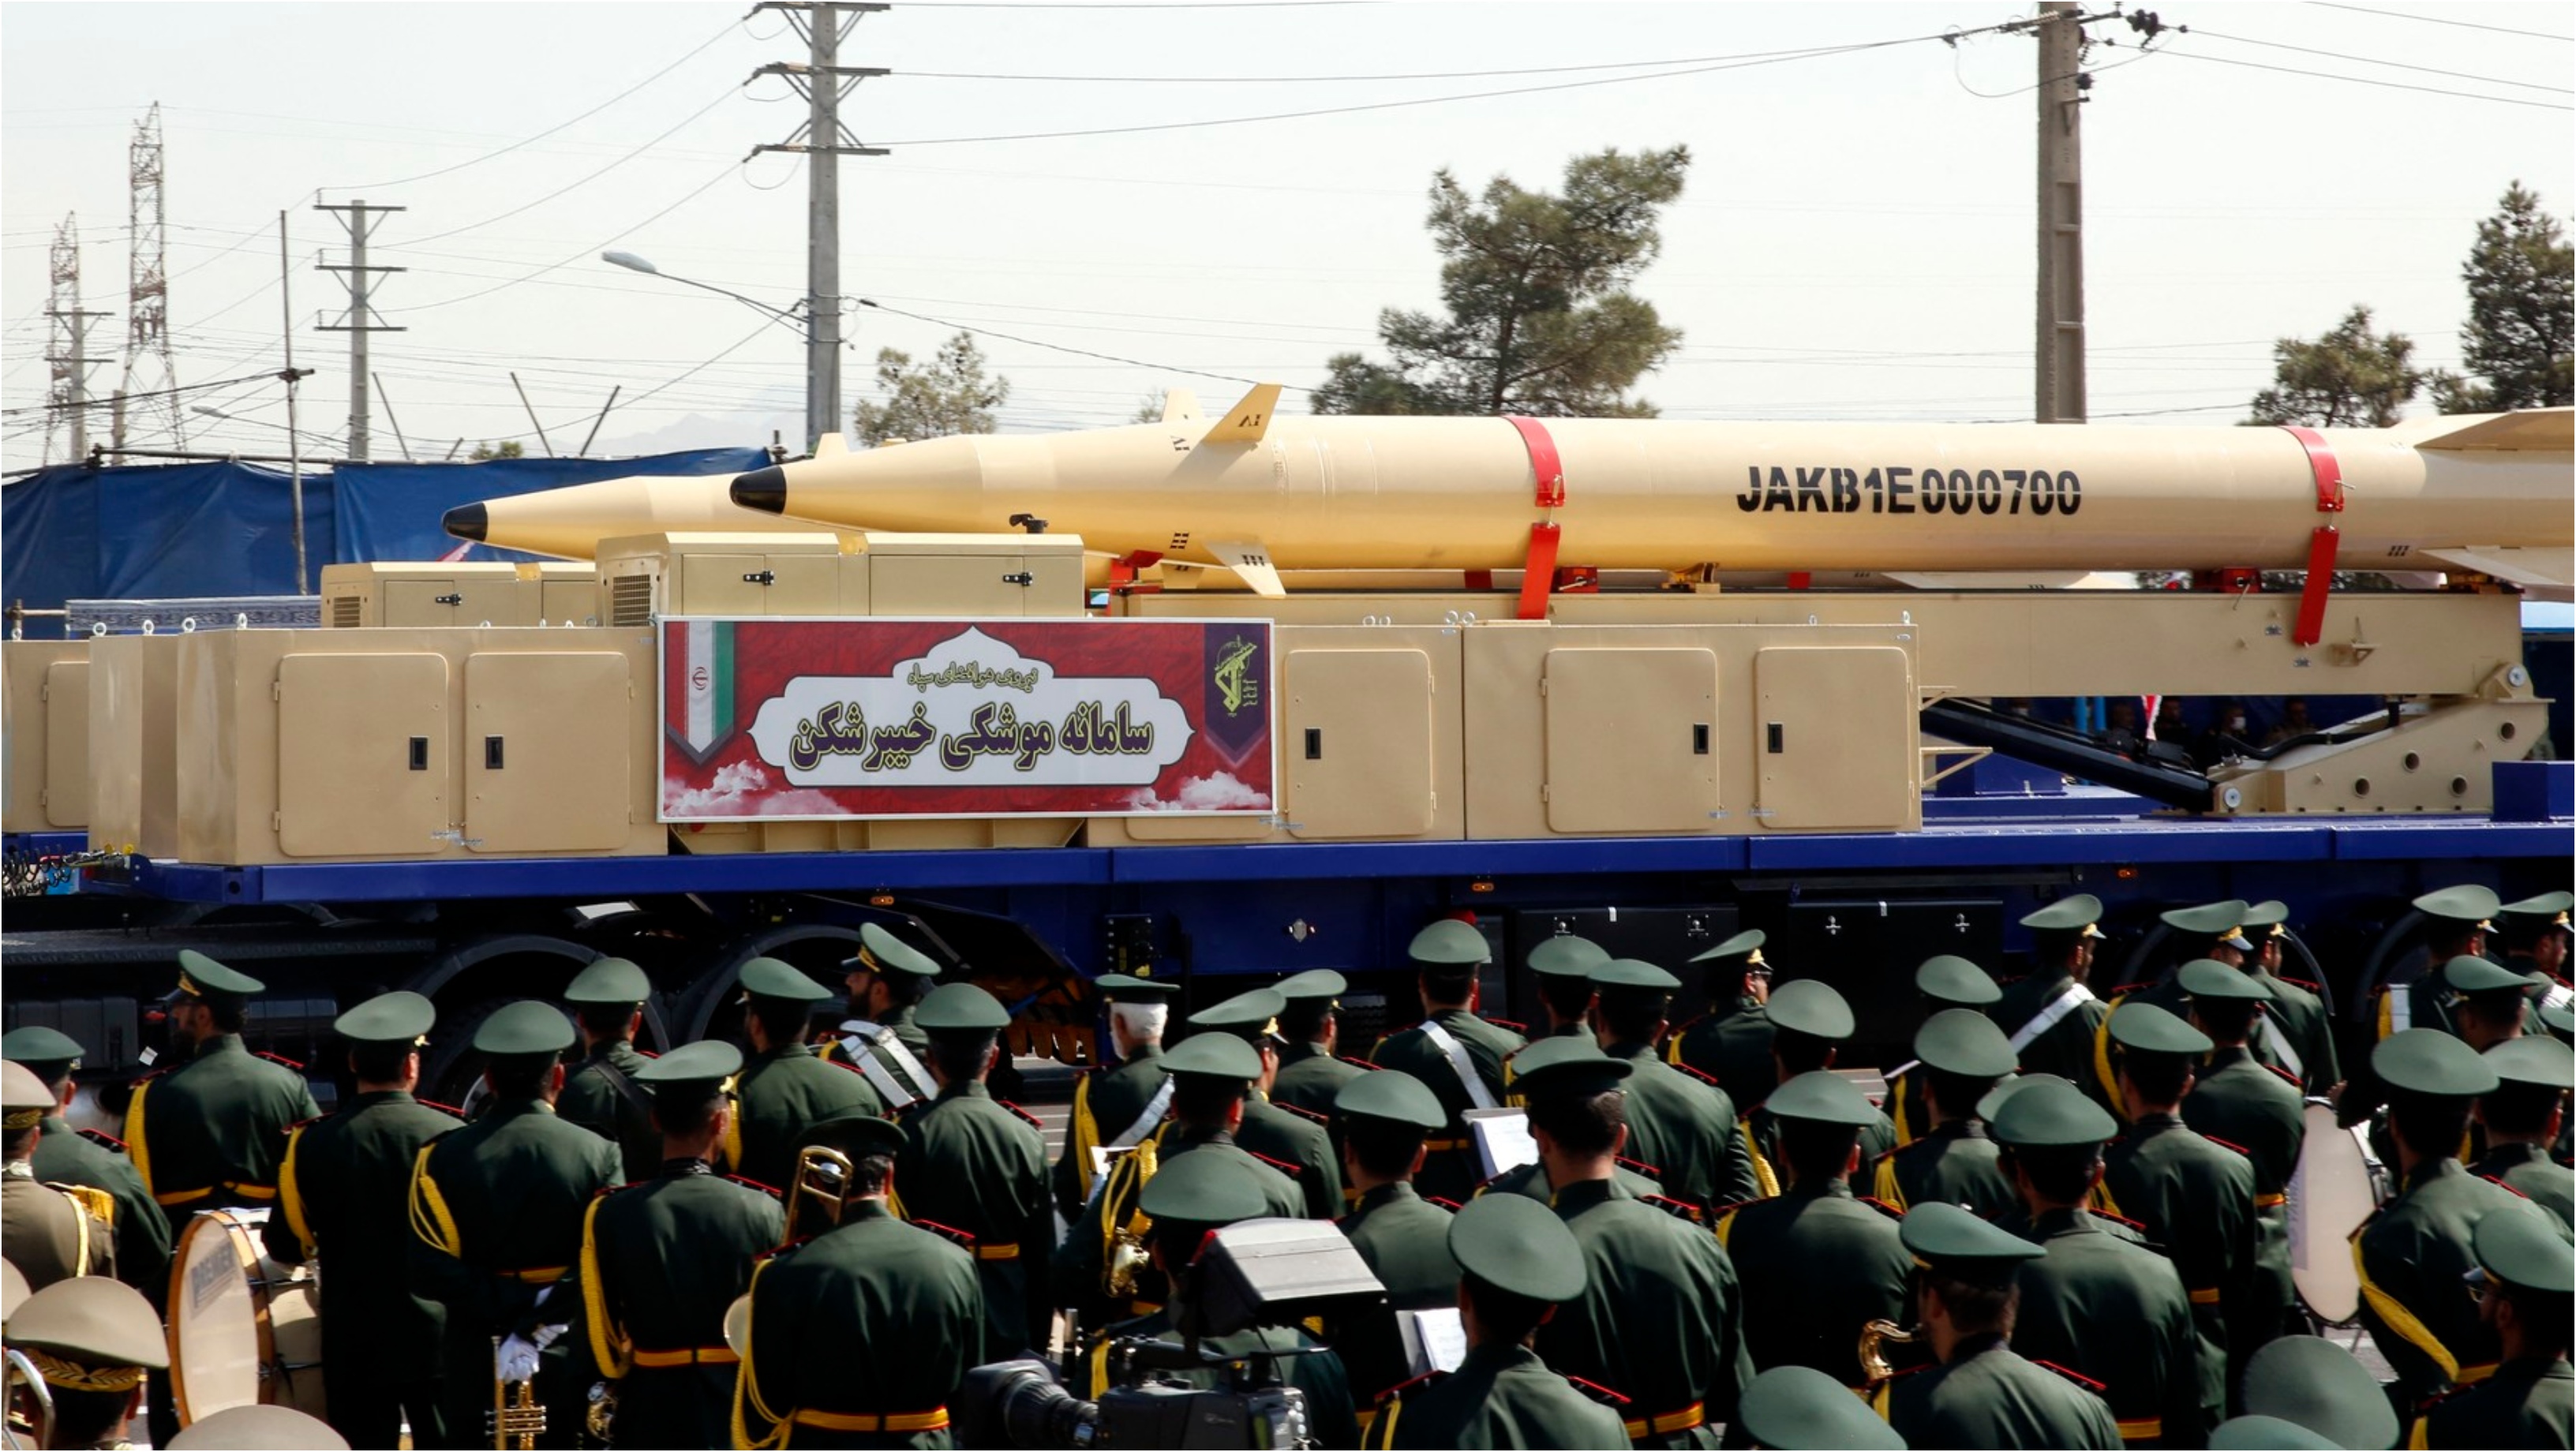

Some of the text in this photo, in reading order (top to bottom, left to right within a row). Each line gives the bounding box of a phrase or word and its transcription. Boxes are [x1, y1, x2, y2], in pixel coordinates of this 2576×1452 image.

[907, 662, 934, 693] سپاه
[939, 701, 1056, 772] موشکی
[1058, 700, 1155, 754] سامانه
